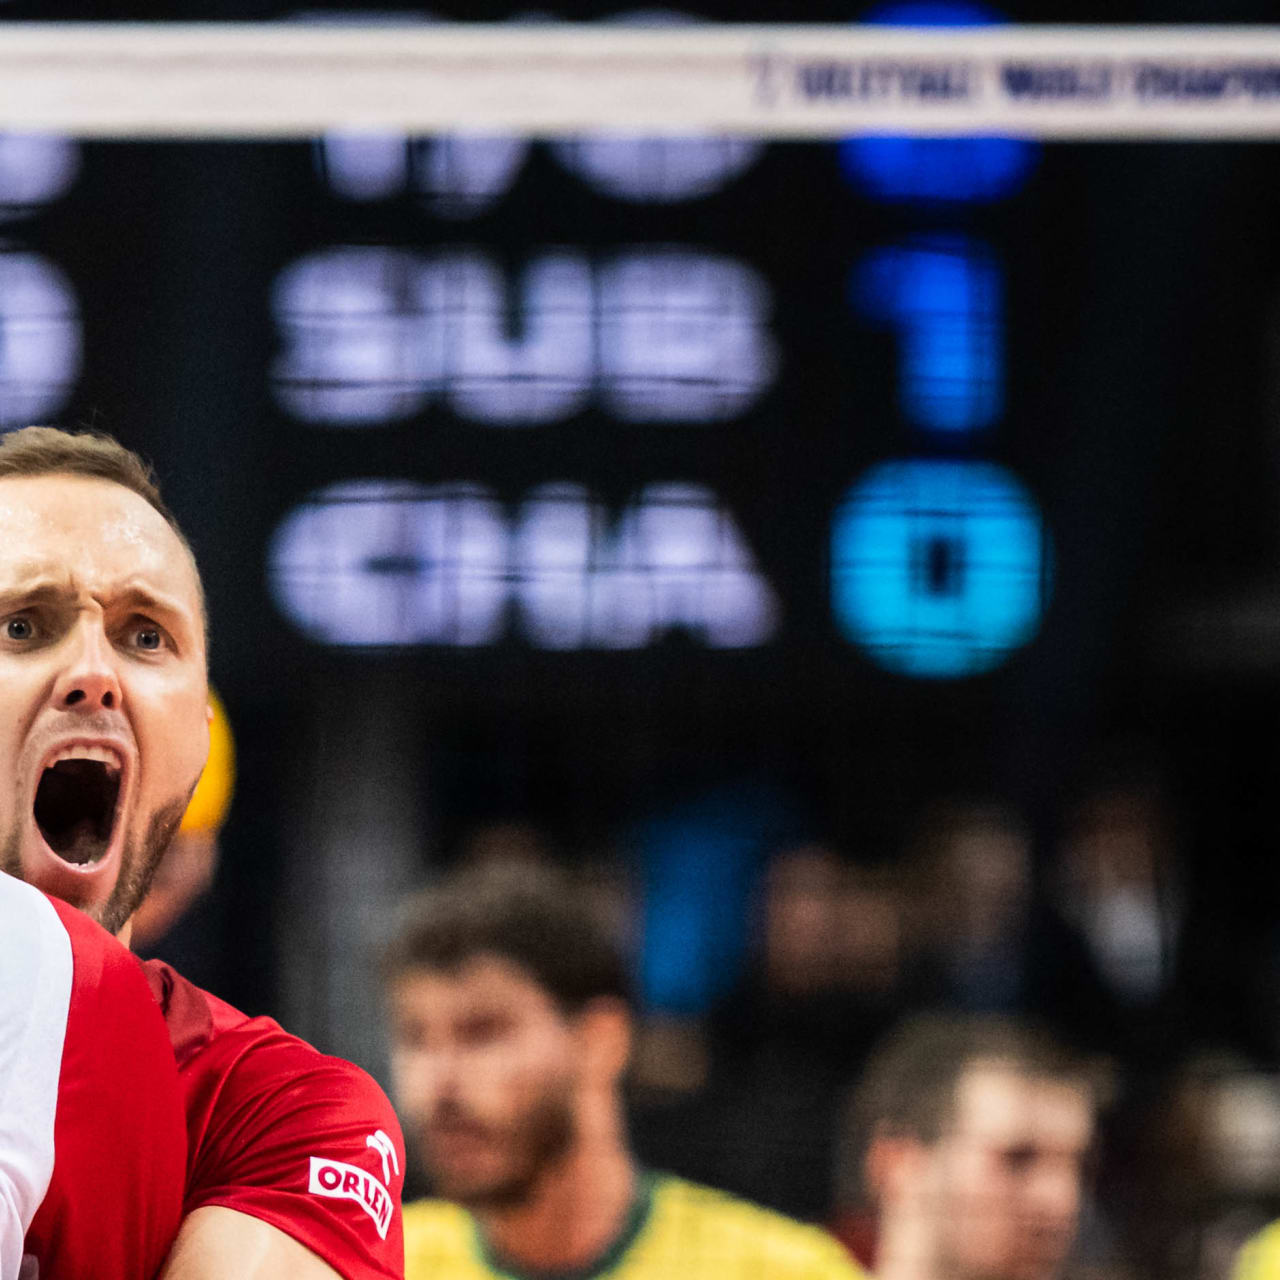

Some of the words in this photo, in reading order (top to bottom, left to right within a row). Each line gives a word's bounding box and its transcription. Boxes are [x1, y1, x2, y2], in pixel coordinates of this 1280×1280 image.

[270, 244, 777, 425] SUB
[268, 477, 778, 651] CHA
[830, 459, 1051, 680] 0
[318, 1166, 391, 1229] ORLEN
